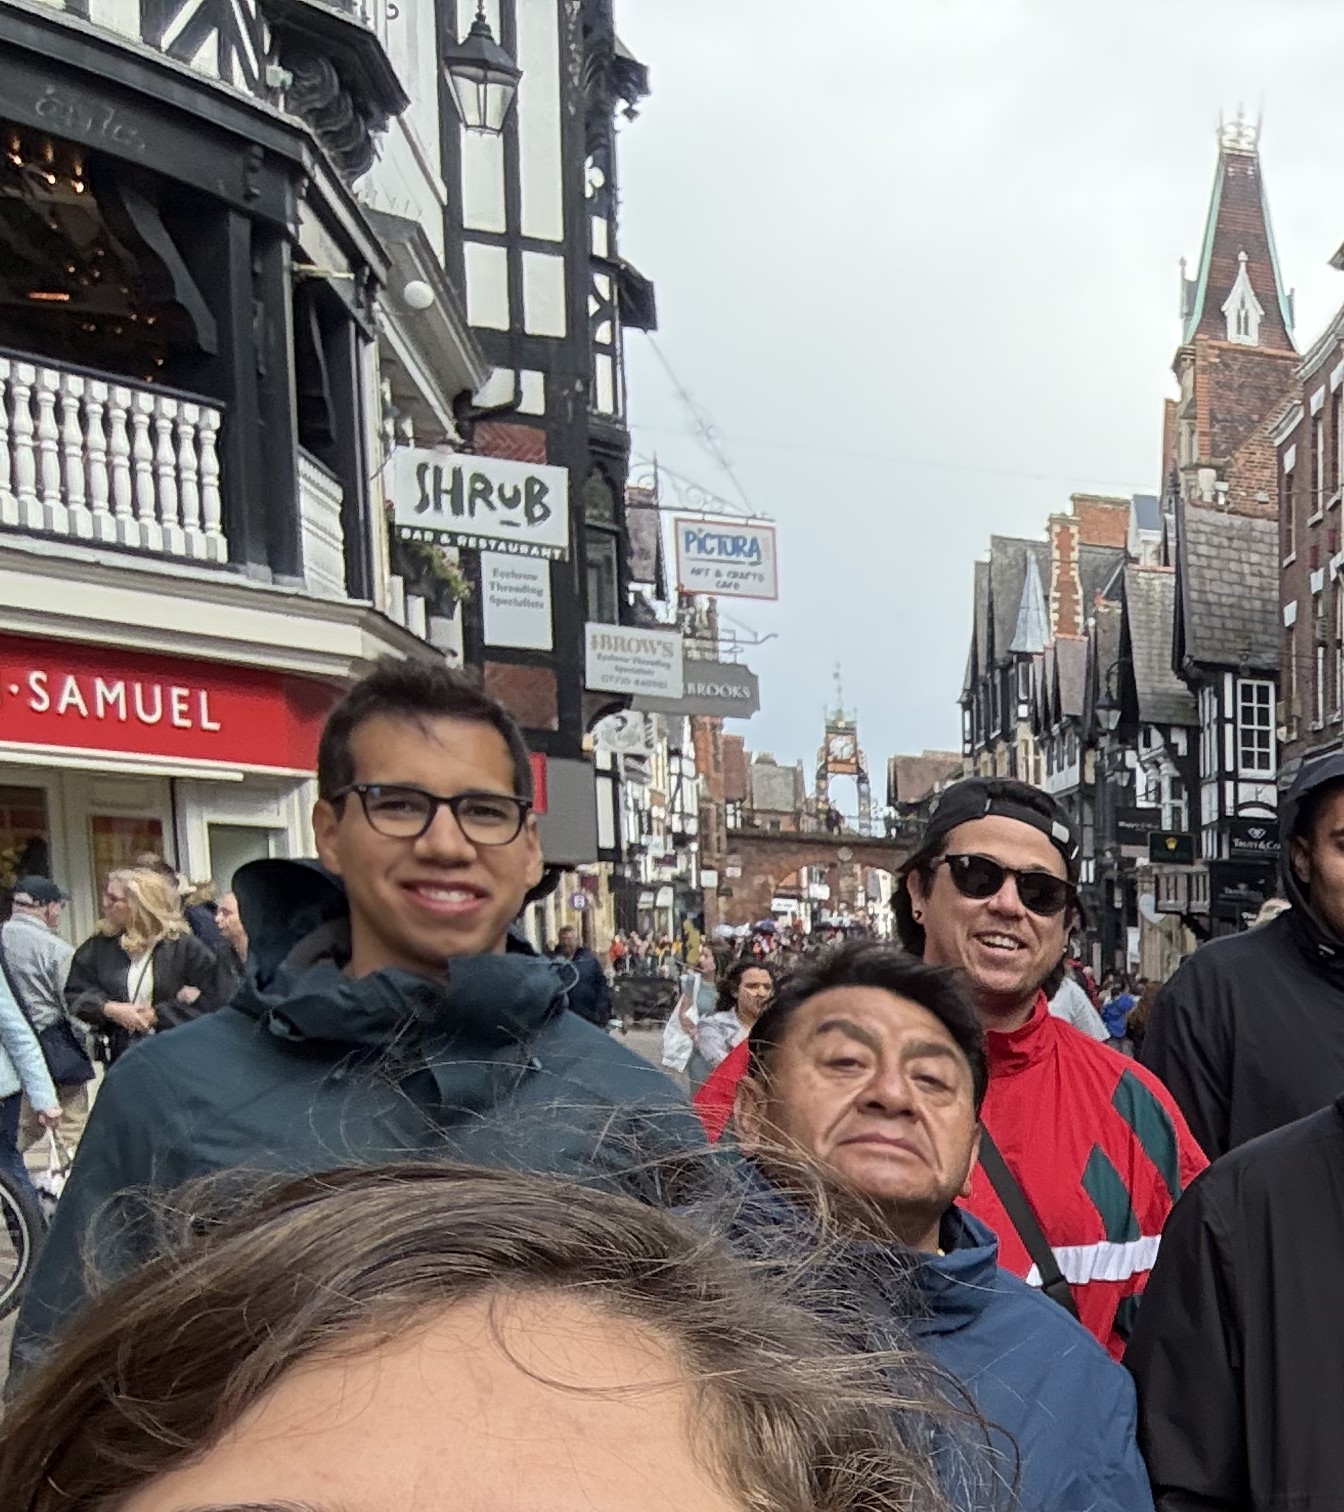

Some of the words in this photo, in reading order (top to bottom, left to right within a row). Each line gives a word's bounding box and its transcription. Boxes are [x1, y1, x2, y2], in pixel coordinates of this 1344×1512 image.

[413, 462, 552, 527] SHRUB
[401, 527, 433, 542] BAR
[440, 532, 451, 544] &
[457, 535, 562, 560] RESTAURANT
